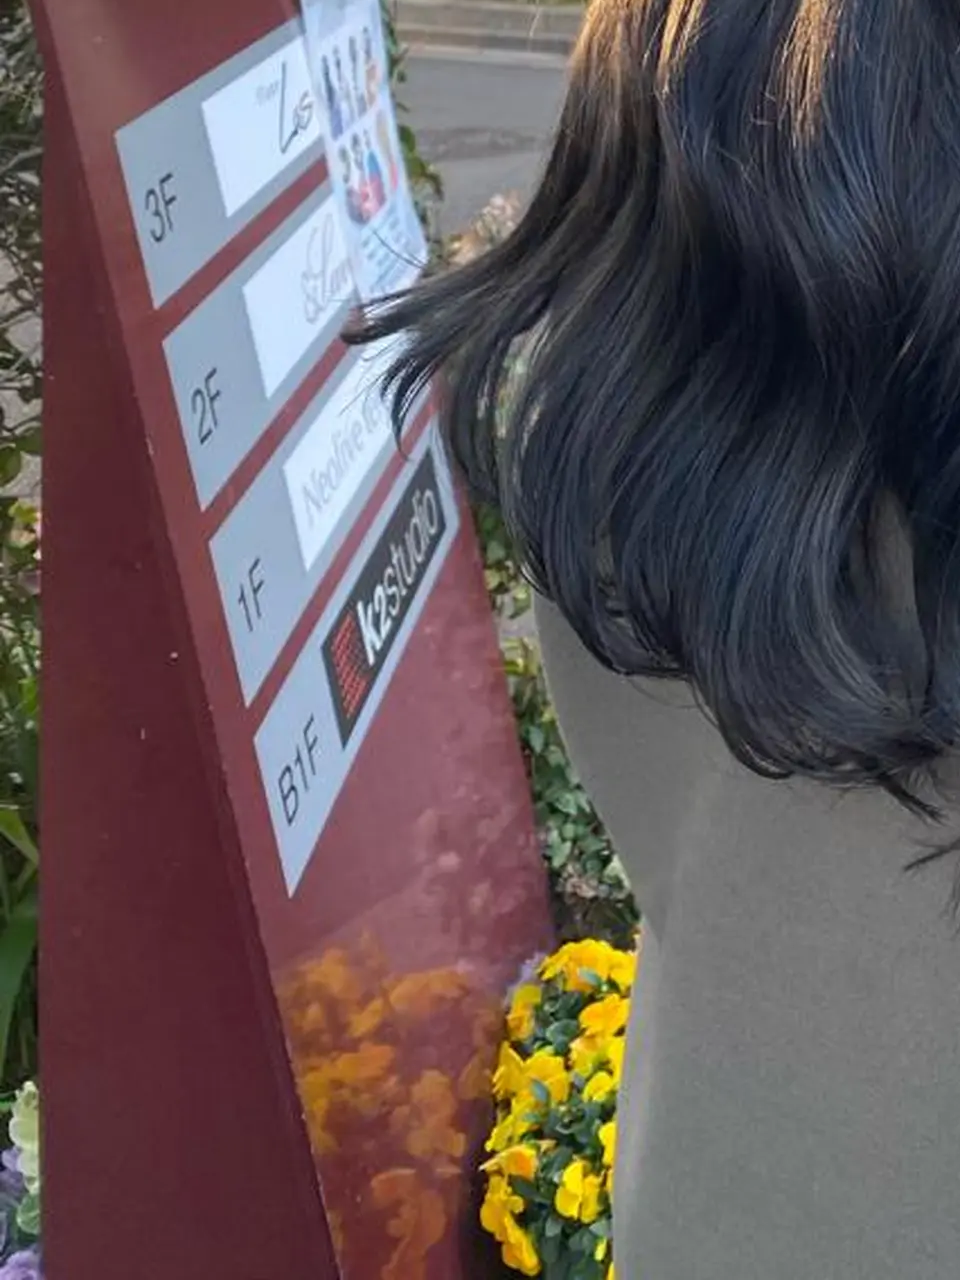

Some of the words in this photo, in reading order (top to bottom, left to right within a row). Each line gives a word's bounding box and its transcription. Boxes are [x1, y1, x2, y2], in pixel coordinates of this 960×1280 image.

[145, 173, 176, 243] 3F
[190, 368, 223, 444] 2F
[237, 558, 267, 632] 1F
[277, 715, 320, 827] B1F
